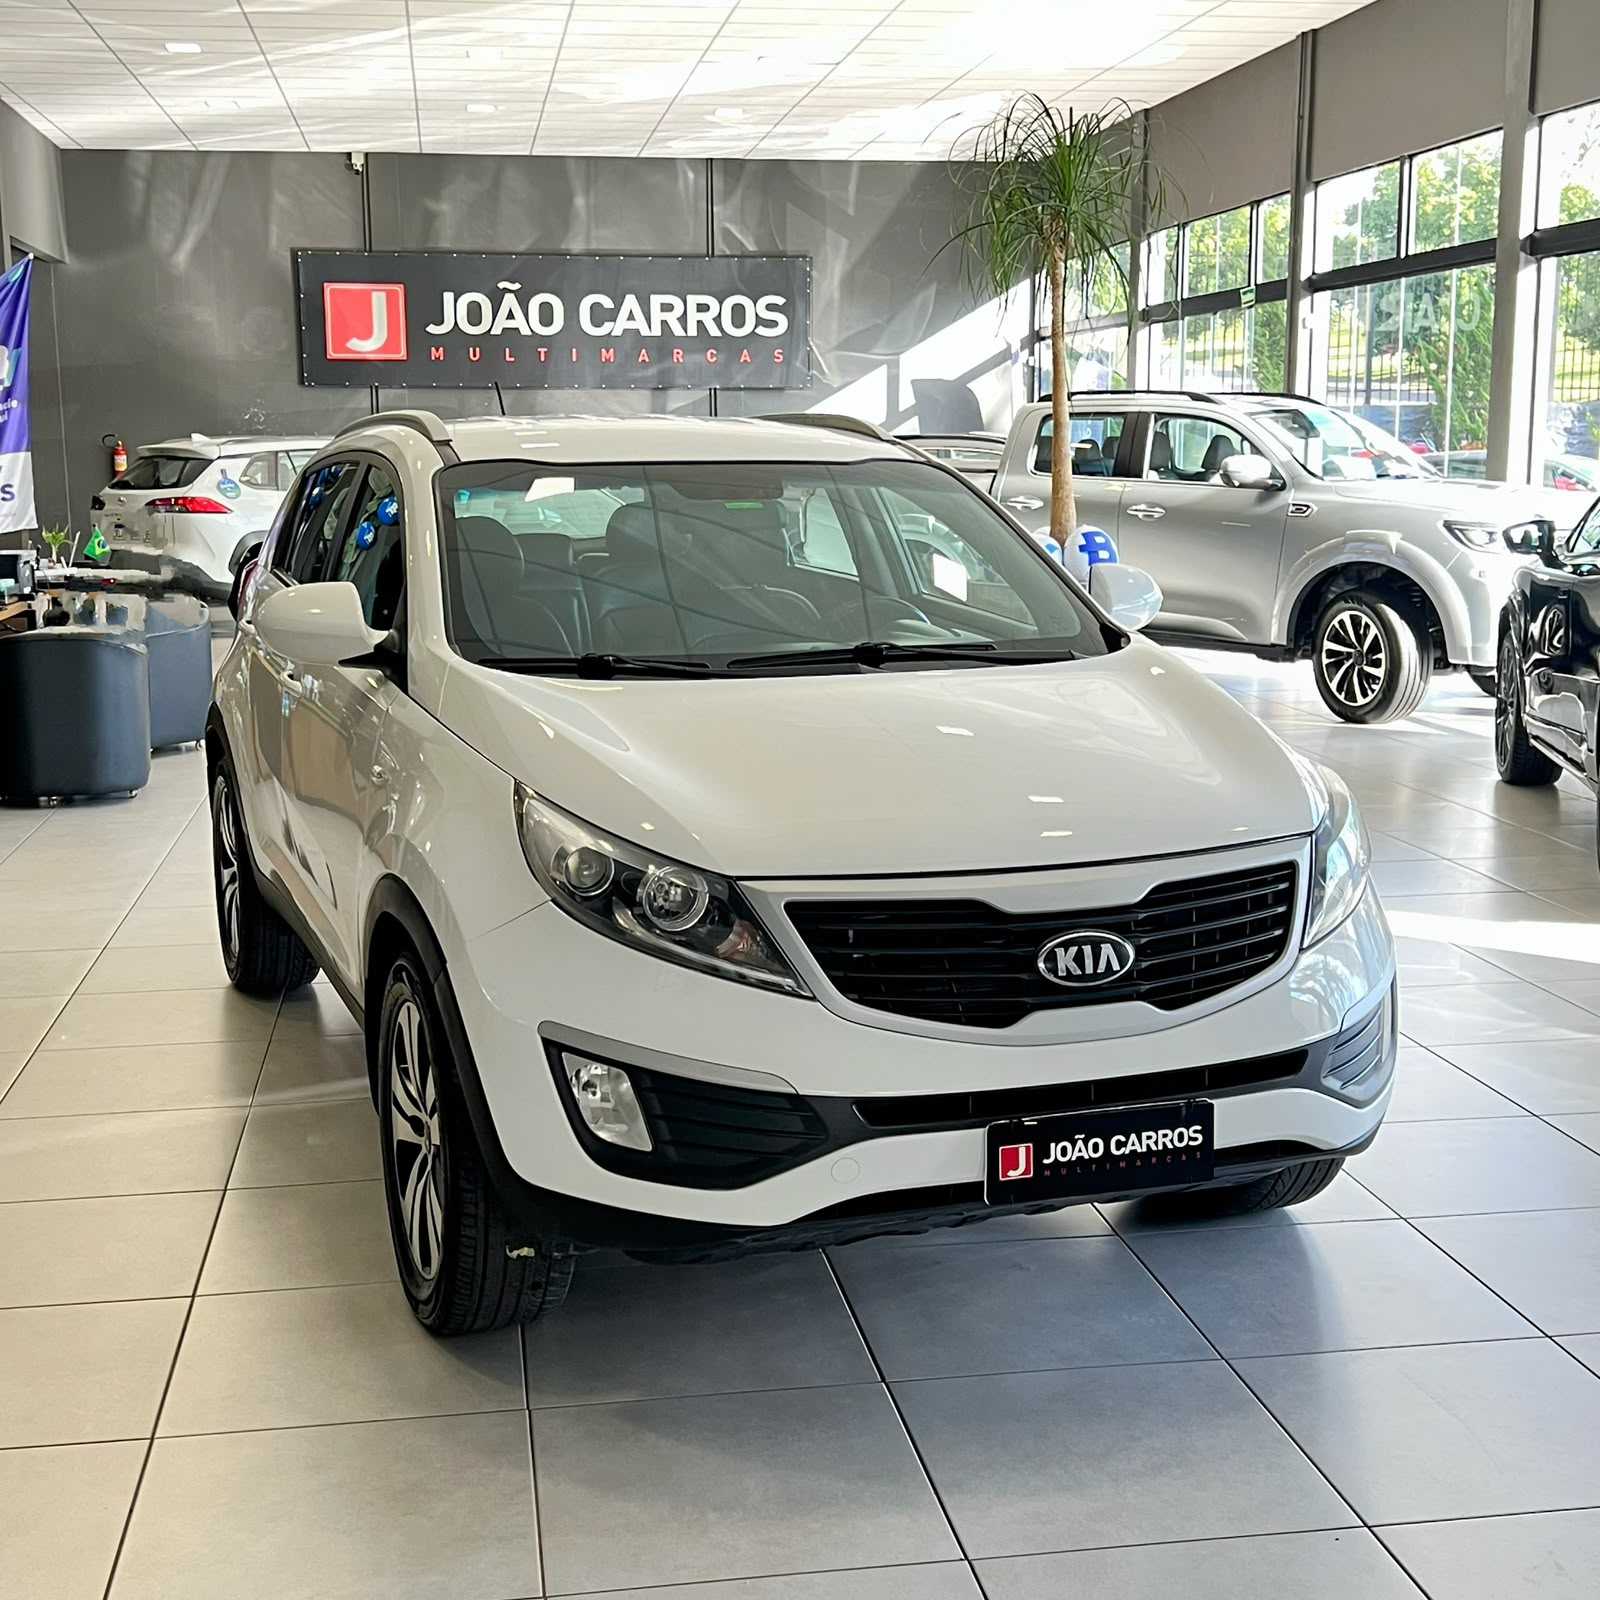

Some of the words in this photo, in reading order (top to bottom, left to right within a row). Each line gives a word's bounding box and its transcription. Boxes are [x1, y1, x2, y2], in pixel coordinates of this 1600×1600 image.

[345, 291, 385, 352] J
[425, 281, 564, 336] JOÃO
[579, 294, 789, 337] CARROS
[431, 346, 784, 363] MULTIMARCAS
[1054, 943, 1121, 977] KIA
[1007, 1147, 1026, 1177] J
[1042, 1134, 1104, 1164] JOÃO
[1110, 1125, 1203, 1156] CARROS
